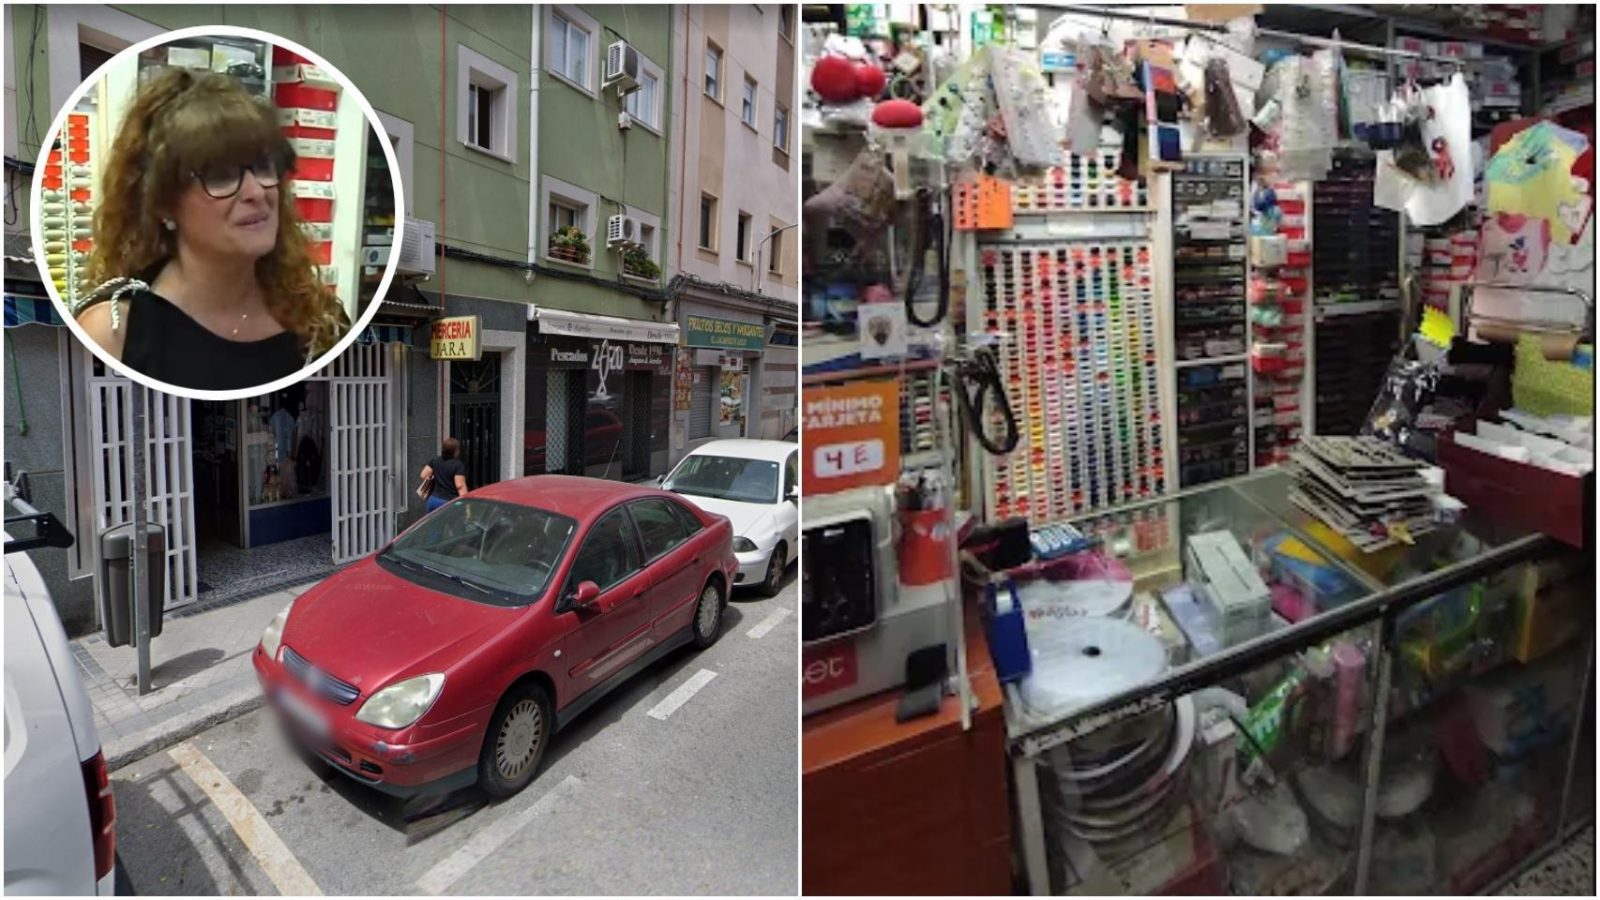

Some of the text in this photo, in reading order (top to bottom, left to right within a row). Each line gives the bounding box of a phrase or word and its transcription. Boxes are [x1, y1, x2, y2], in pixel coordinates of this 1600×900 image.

[433, 320, 471, 338] MERCERIA
[435, 342, 465, 355] JARA
[551, 349, 588, 362] Pescados
[803, 410, 882, 430] ARJETA
[825, 449, 842, 469] 4
